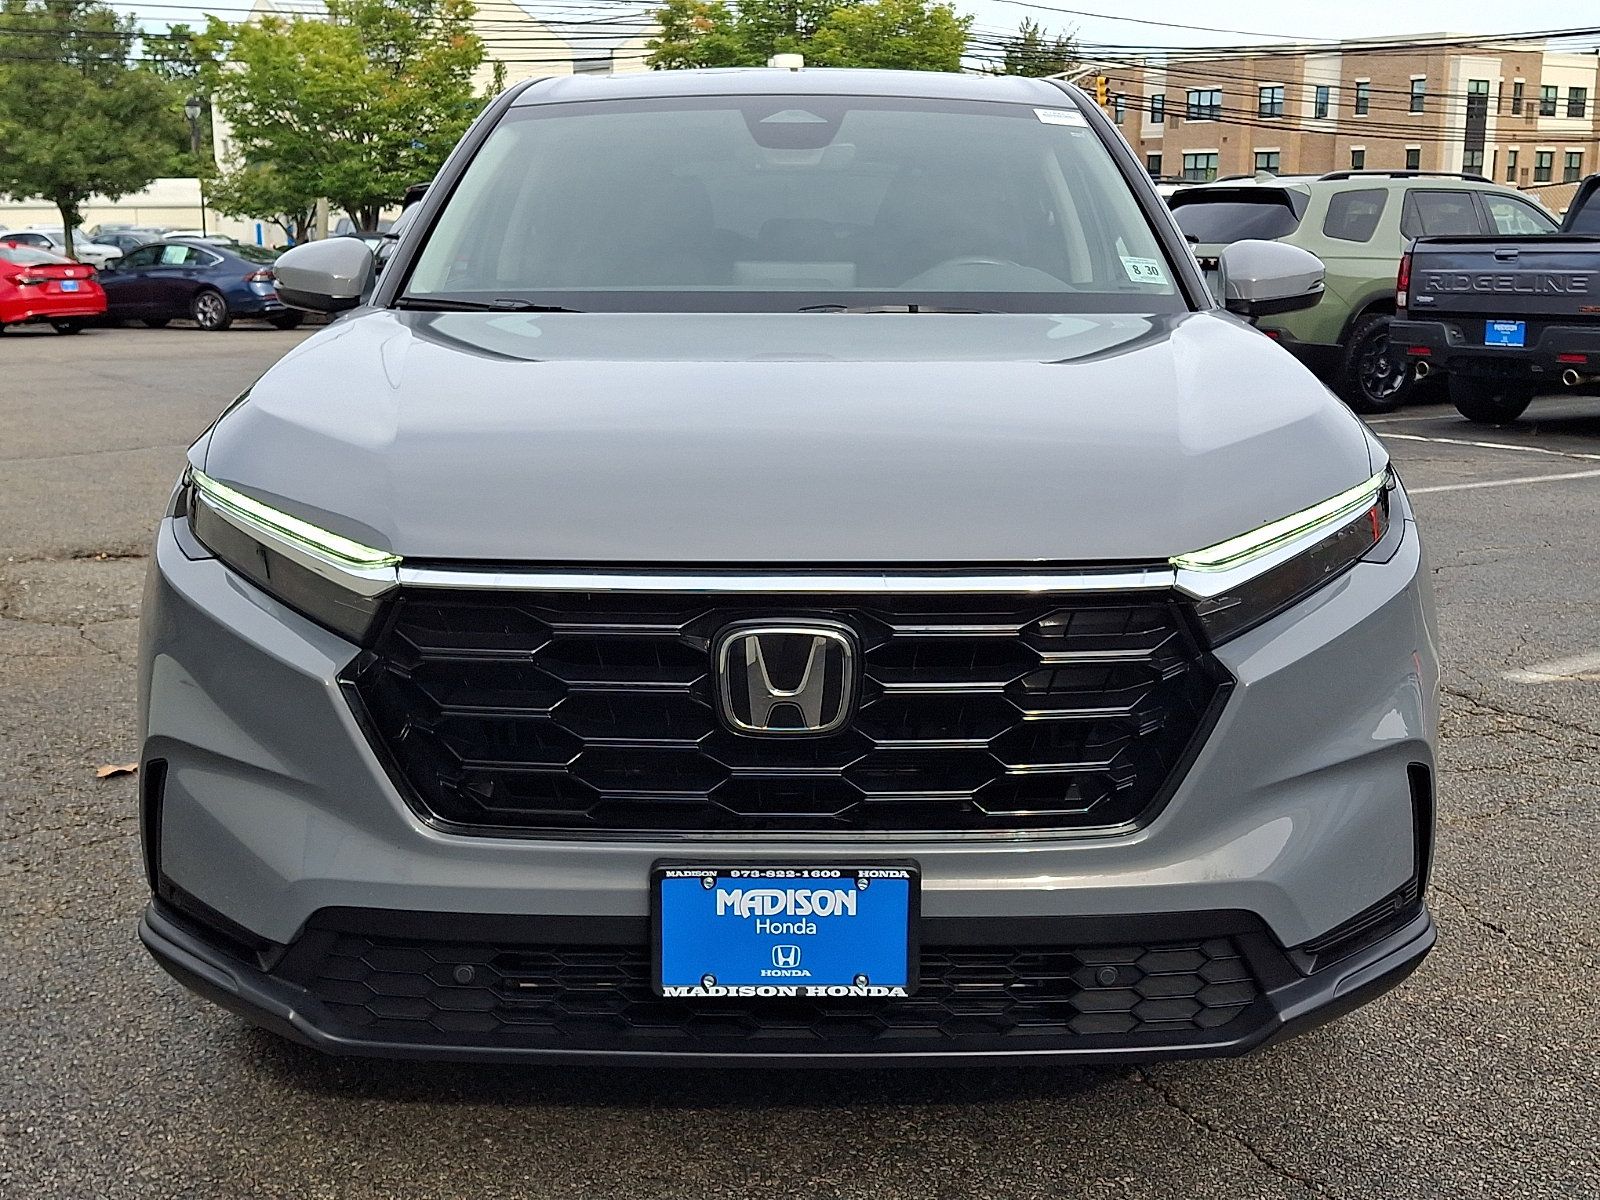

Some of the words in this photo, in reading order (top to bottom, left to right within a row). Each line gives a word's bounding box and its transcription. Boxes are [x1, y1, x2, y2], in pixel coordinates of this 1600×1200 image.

[1132, 264, 1142, 275] 8
[1144, 265, 1159, 276] 30
[1424, 274, 1589, 293] RIDGELINE
[730, 870, 841, 878] 973-822-1600
[857, 870, 910, 878] HONDA
[716, 888, 857, 919] MADISON
[756, 917, 817, 935] Honda
[760, 969, 812, 977] HONDA
[662, 986, 798, 997] MADISON
[805, 986, 909, 997] HONDA
